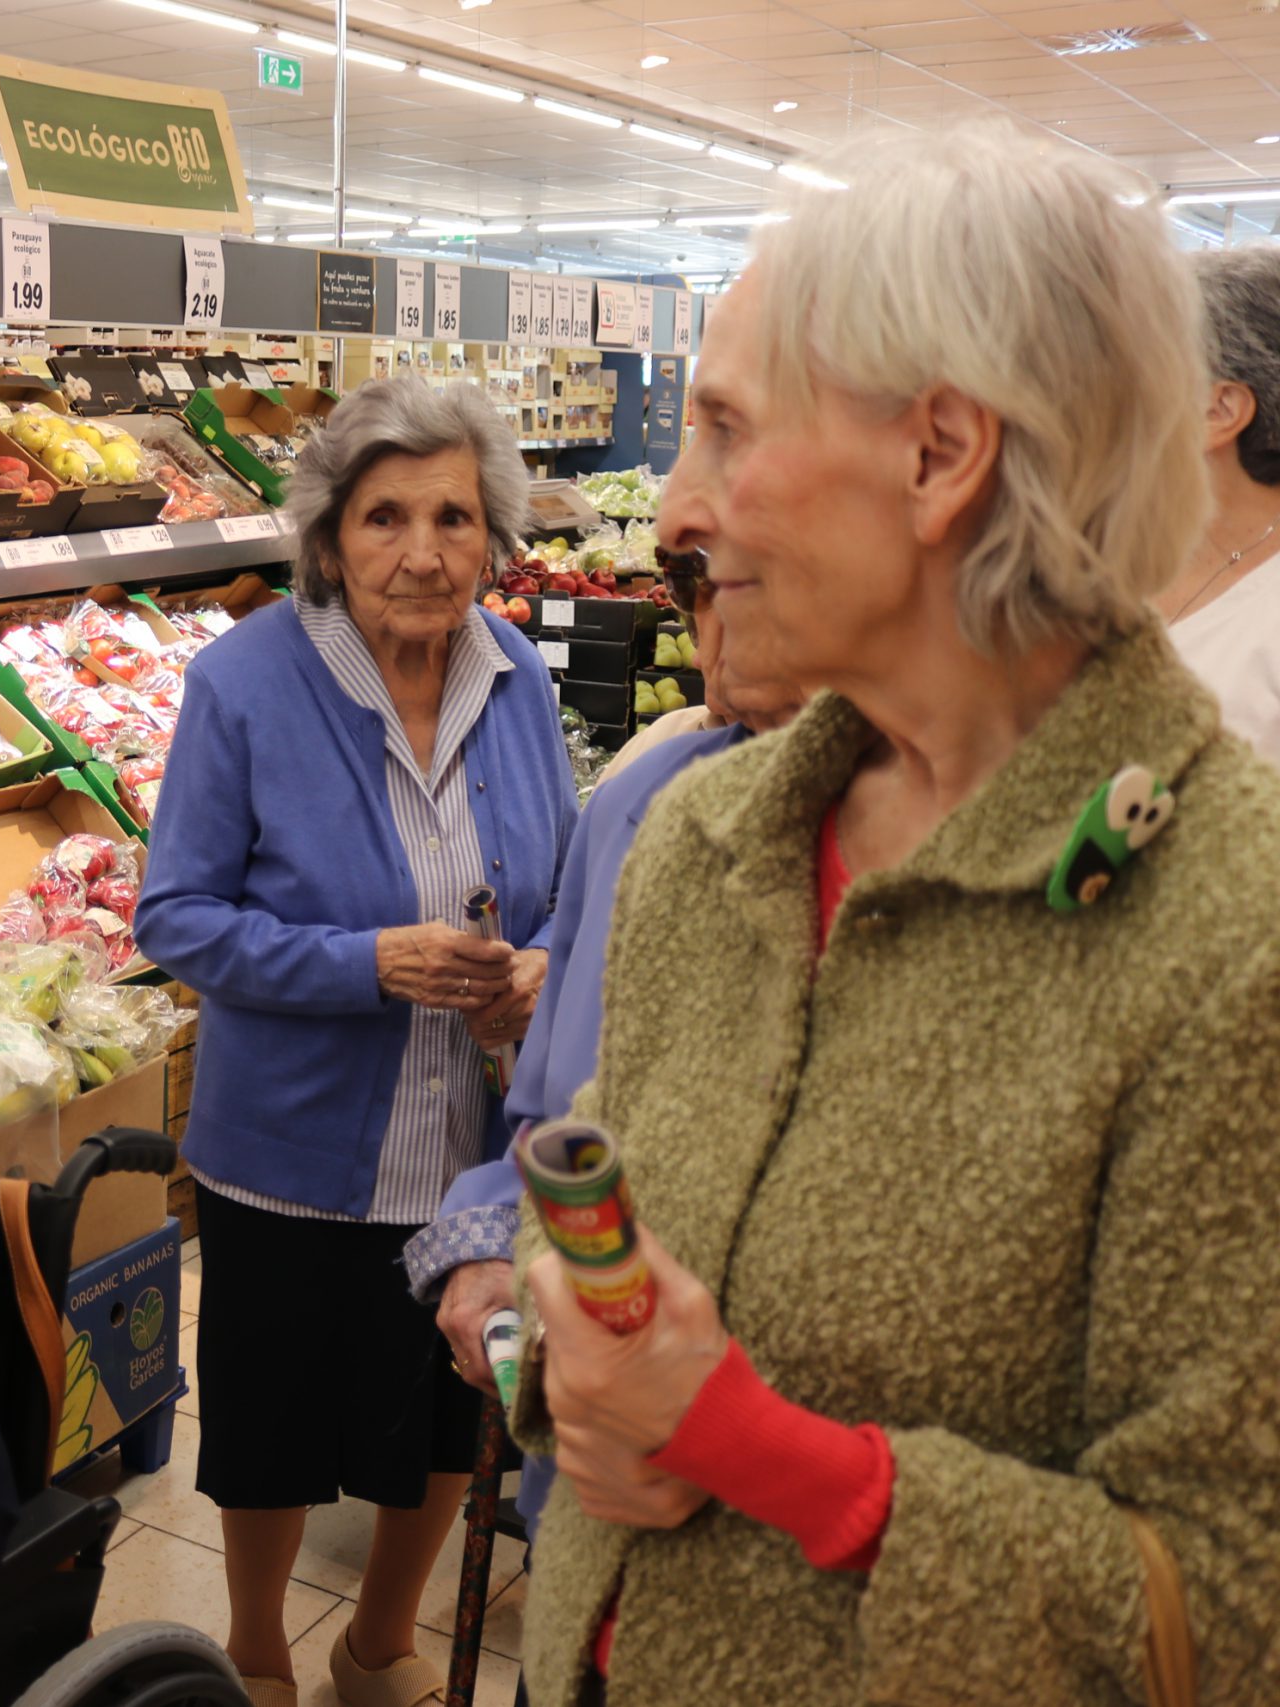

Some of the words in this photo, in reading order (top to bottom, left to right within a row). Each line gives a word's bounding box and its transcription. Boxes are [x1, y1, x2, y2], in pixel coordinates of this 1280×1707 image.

[22, 119, 170, 168] ECOLÓGICO
[12, 231, 42, 243] Paraguayo
[12, 281, 43, 310] 1.99
[191, 293, 218, 318] 2.19
[401, 306, 420, 328] 1.59
[438, 309, 457, 331] 1.85
[512, 314, 528, 334] 1.39
[535, 316, 549, 336] 1.85
[556, 317, 570, 337] 1.79
[151, 528, 169, 543] 1.29
[52, 542, 73, 557] 1.89
[70, 1272, 119, 1312] ORGANIC
[123, 1241, 175, 1282] BANANAS
[129, 1342, 165, 1377] Hoyos
